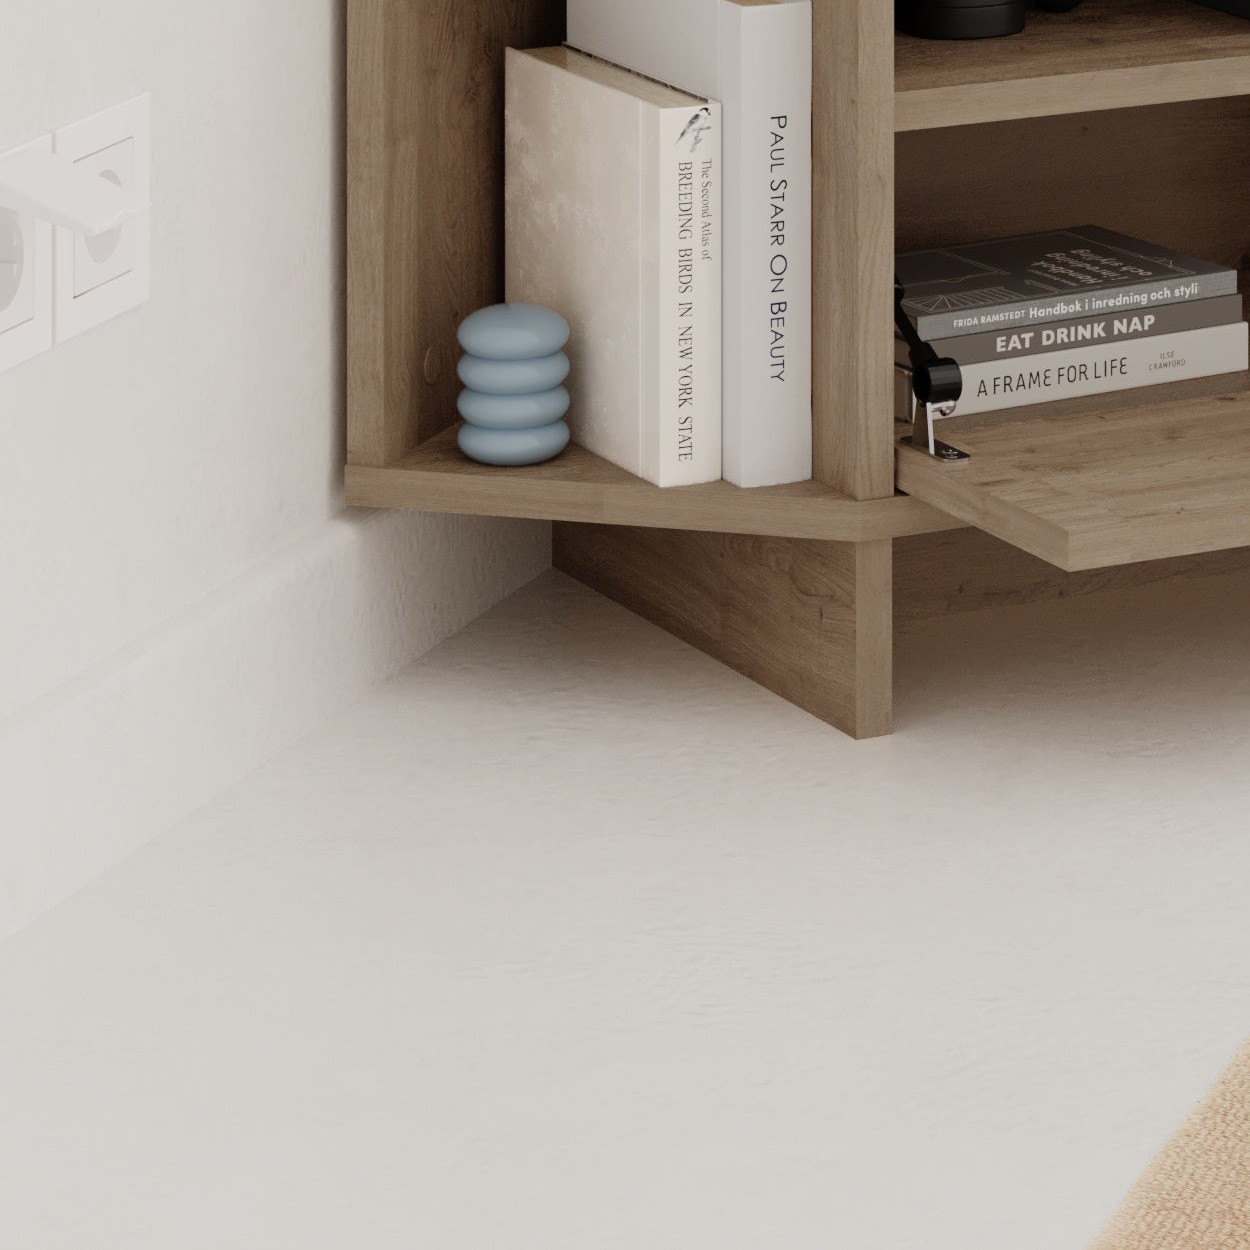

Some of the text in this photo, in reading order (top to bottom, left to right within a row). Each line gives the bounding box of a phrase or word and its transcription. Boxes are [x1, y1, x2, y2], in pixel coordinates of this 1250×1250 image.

[701, 158, 713, 261] The Second Atlas of
[769, 115, 788, 383] PAUL STARR ON BEAUTY
[678, 161, 693, 462] BREEDING BIRDS IN NEW YORK STATE
[953, 282, 1198, 328] FRIDA RAMSTEDT Handbok i inredning och styli
[996, 314, 1156, 353] EAT DRINK NAP
[1159, 350, 1176, 360] ILSE
[977, 357, 1128, 398] A FRAME FOR LIFE
